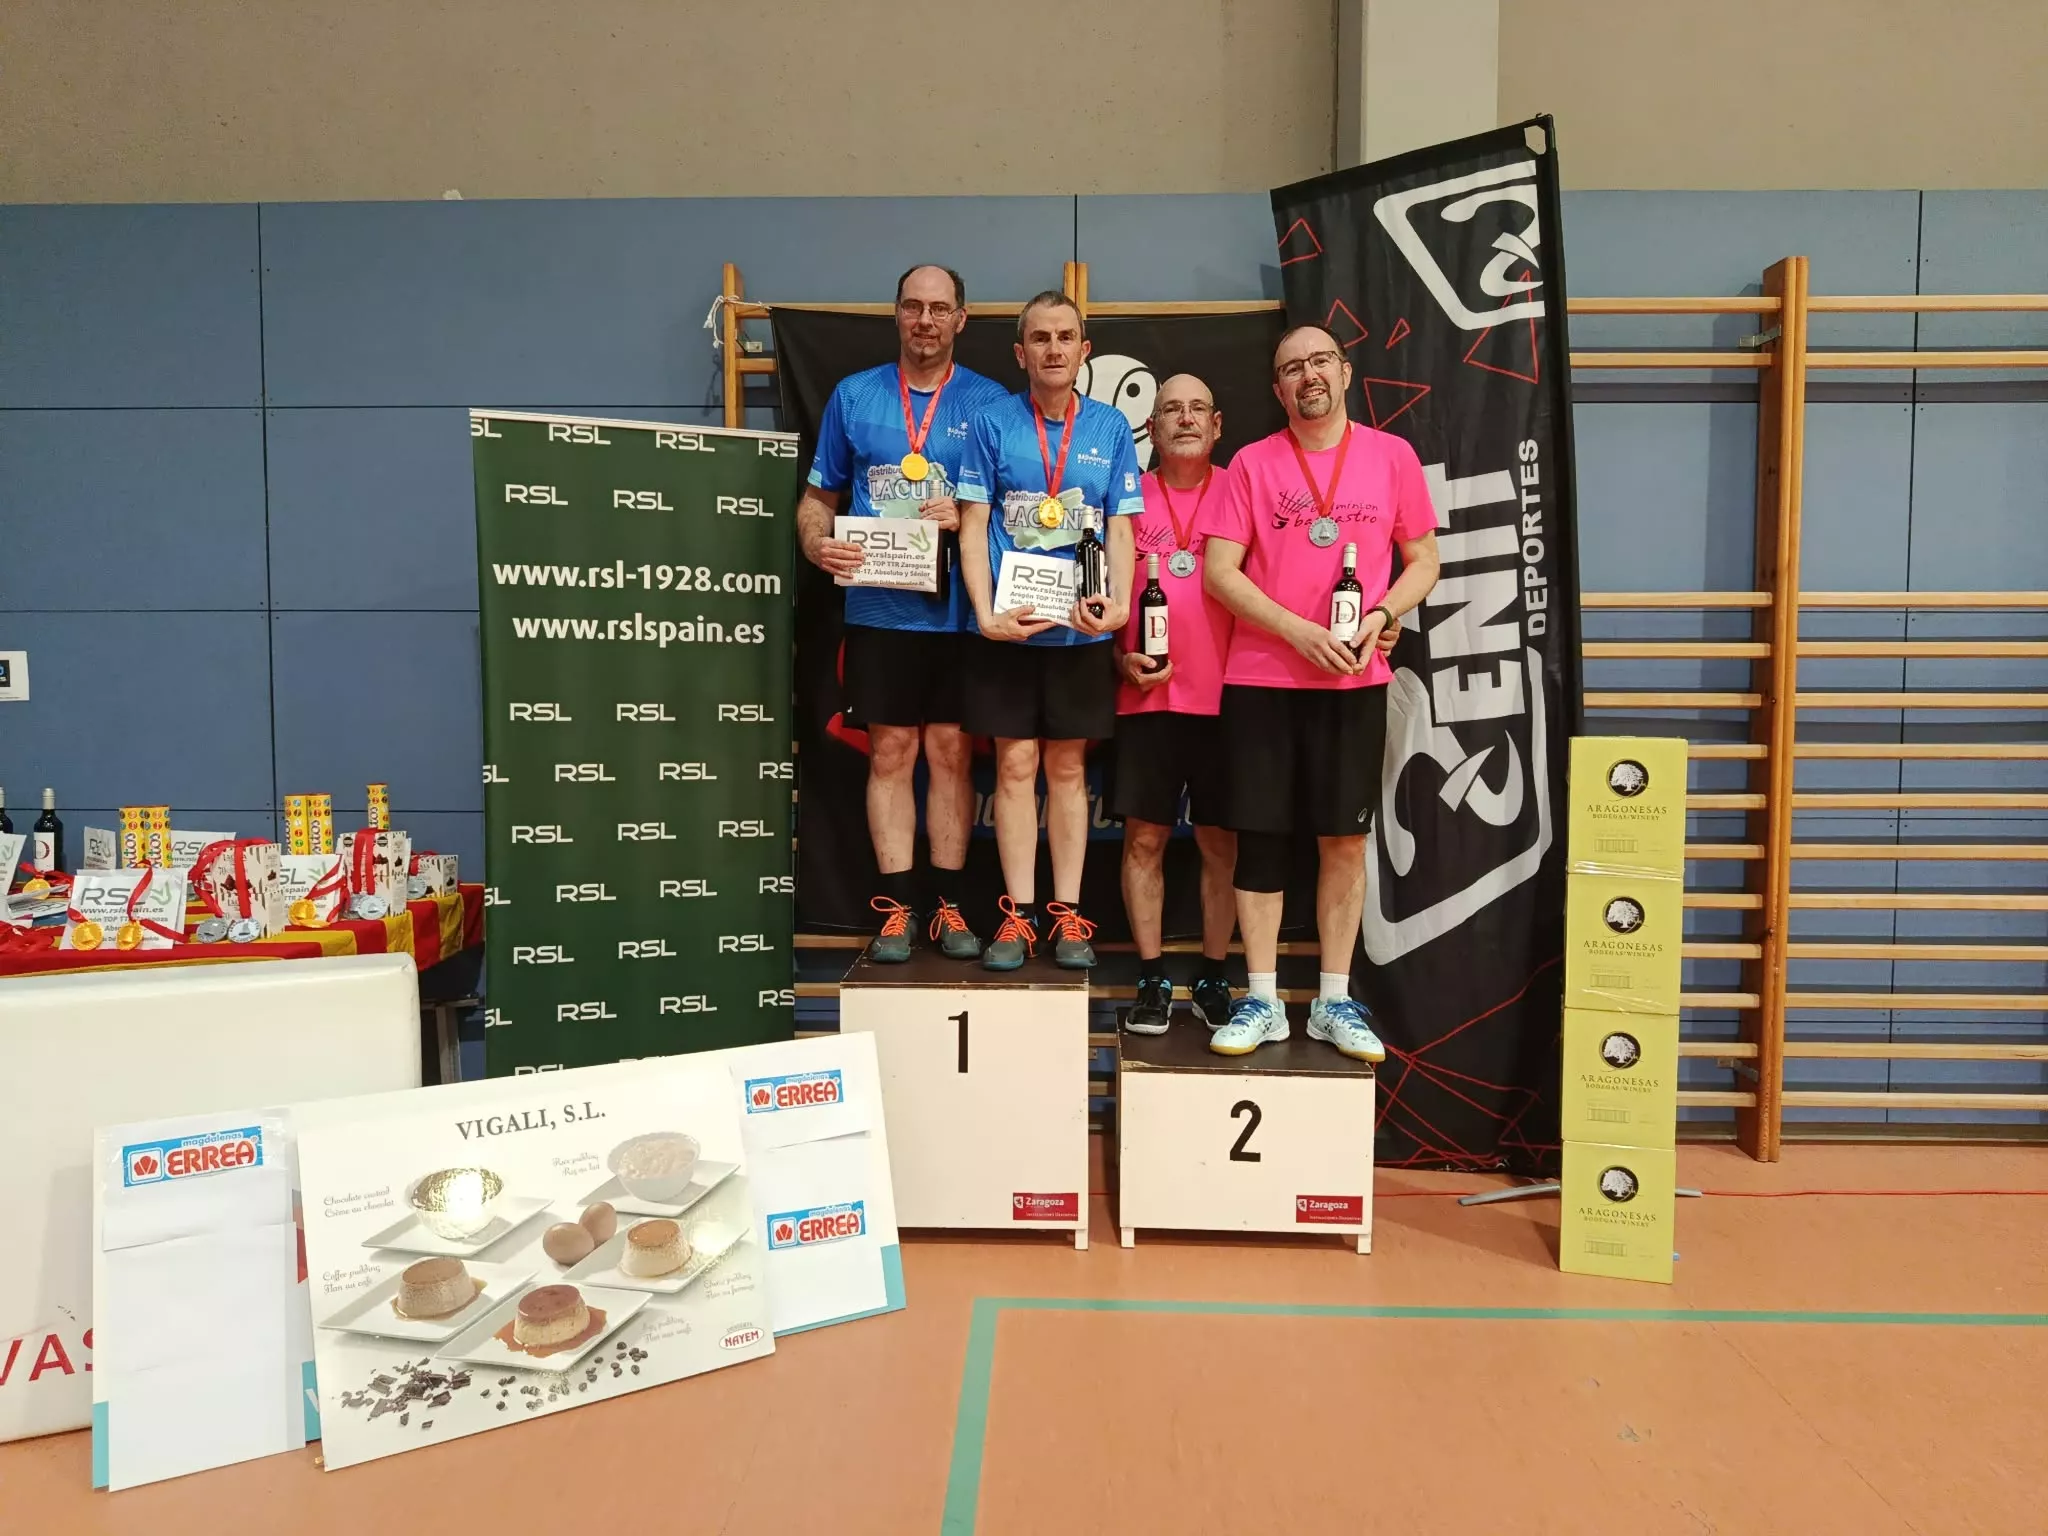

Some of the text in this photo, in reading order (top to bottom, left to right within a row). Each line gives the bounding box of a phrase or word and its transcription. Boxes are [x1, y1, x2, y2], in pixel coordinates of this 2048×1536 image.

[549, 423, 611, 445] RSL
[655, 432, 716, 453] RSL
[505, 483, 568, 506] RSL
[613, 489, 674, 511] RSL
[716, 496, 774, 517] RSL
[847, 530, 907, 550] RSL
[1518, 438, 1548, 637] DEPORTES
[492, 559, 781, 595] www.rsl-1928.com
[1012, 565, 1073, 590] RSL
[1334, 600, 1356, 624] D
[512, 612, 766, 648] www.rslspain.es
[1148, 615, 1167, 638] D
[509, 702, 572, 722] RSL
[616, 703, 676, 722] RSL
[718, 703, 774, 722] RSL
[555, 763, 616, 782] RSL
[659, 762, 717, 780] RSL
[1586, 804, 1667, 814] ARAGONESAS
[511, 825, 573, 844] RSL
[617, 822, 676, 841] RSL
[718, 820, 775, 838] RSL
[279, 868, 306, 885] SL
[556, 883, 616, 902] RSL
[659, 879, 717, 898] RSL
[618, 939, 677, 959] RSL
[718, 934, 774, 953] RSL
[1583, 940, 1663, 952] ARAGONESAS
[513, 945, 575, 965] RSL
[557, 1001, 617, 1022] RSL
[659, 995, 718, 1015] RSL
[948, 1011, 969, 1073] 1
[1580, 1074, 1659, 1087] ARAGONESAS
[776, 1081, 838, 1107] ERREA
[455, 1101, 606, 1140] VIGALI, S.L.
[183, 1132, 242, 1147] magdalenas
[1229, 1100, 1262, 1162] 2
[167, 1140, 255, 1175] ERREA
[1025, 1197, 1064, 1208] Zaragoza
[1309, 1200, 1348, 1211] Zaragoza
[1579, 1207, 1657, 1221] ARAGONESAS
[798, 1213, 860, 1242] ERREA
[724, 1330, 760, 1348] NAYEM
